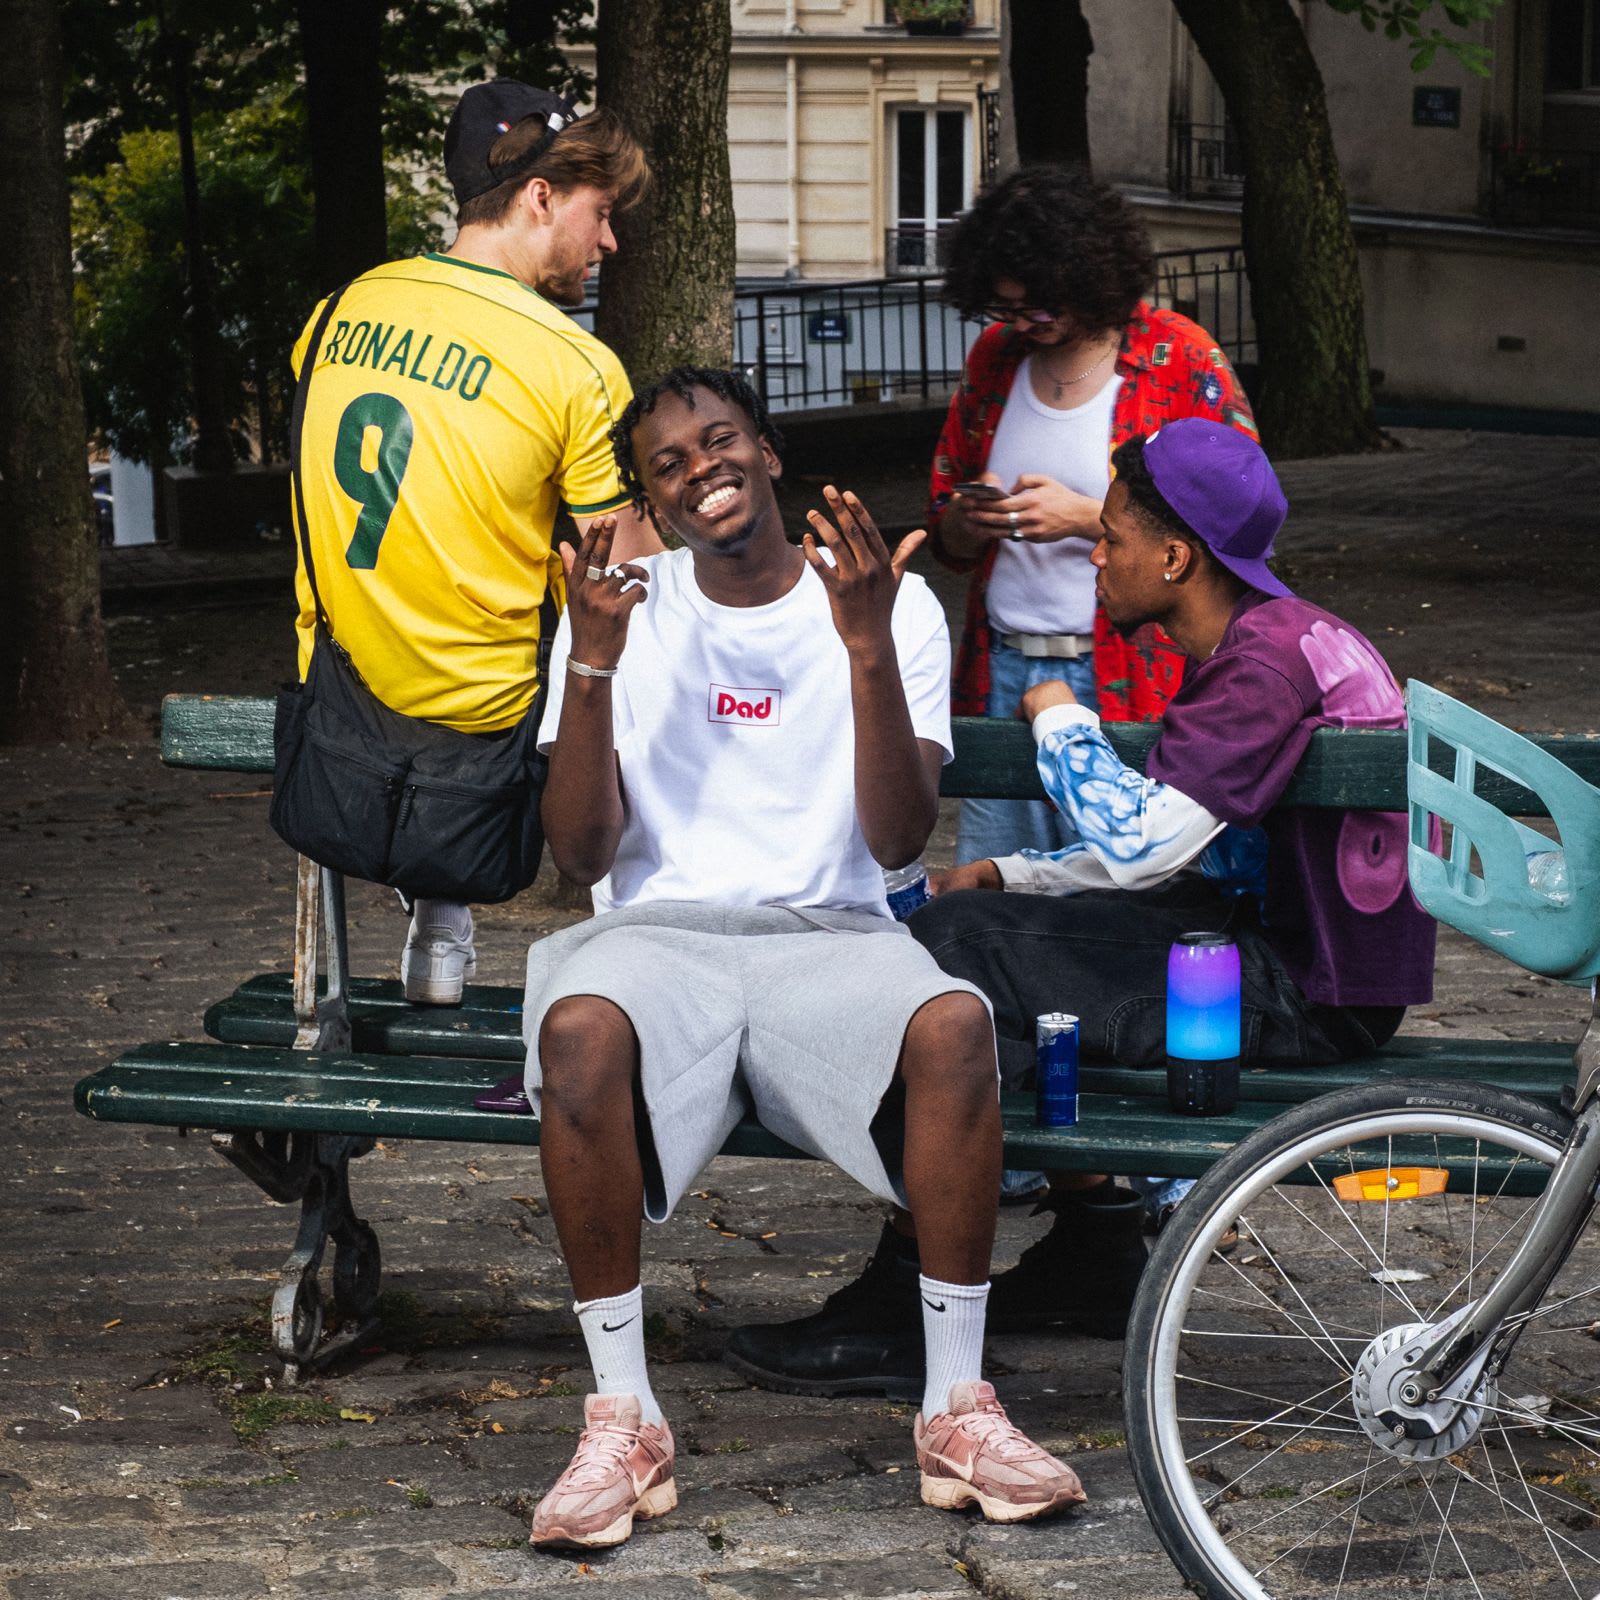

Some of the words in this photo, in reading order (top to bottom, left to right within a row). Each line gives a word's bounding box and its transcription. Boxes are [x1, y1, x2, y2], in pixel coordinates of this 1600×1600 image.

[323, 320, 493, 401] RONALDO
[333, 392, 414, 570] 9
[716, 692, 772, 719] Dad
